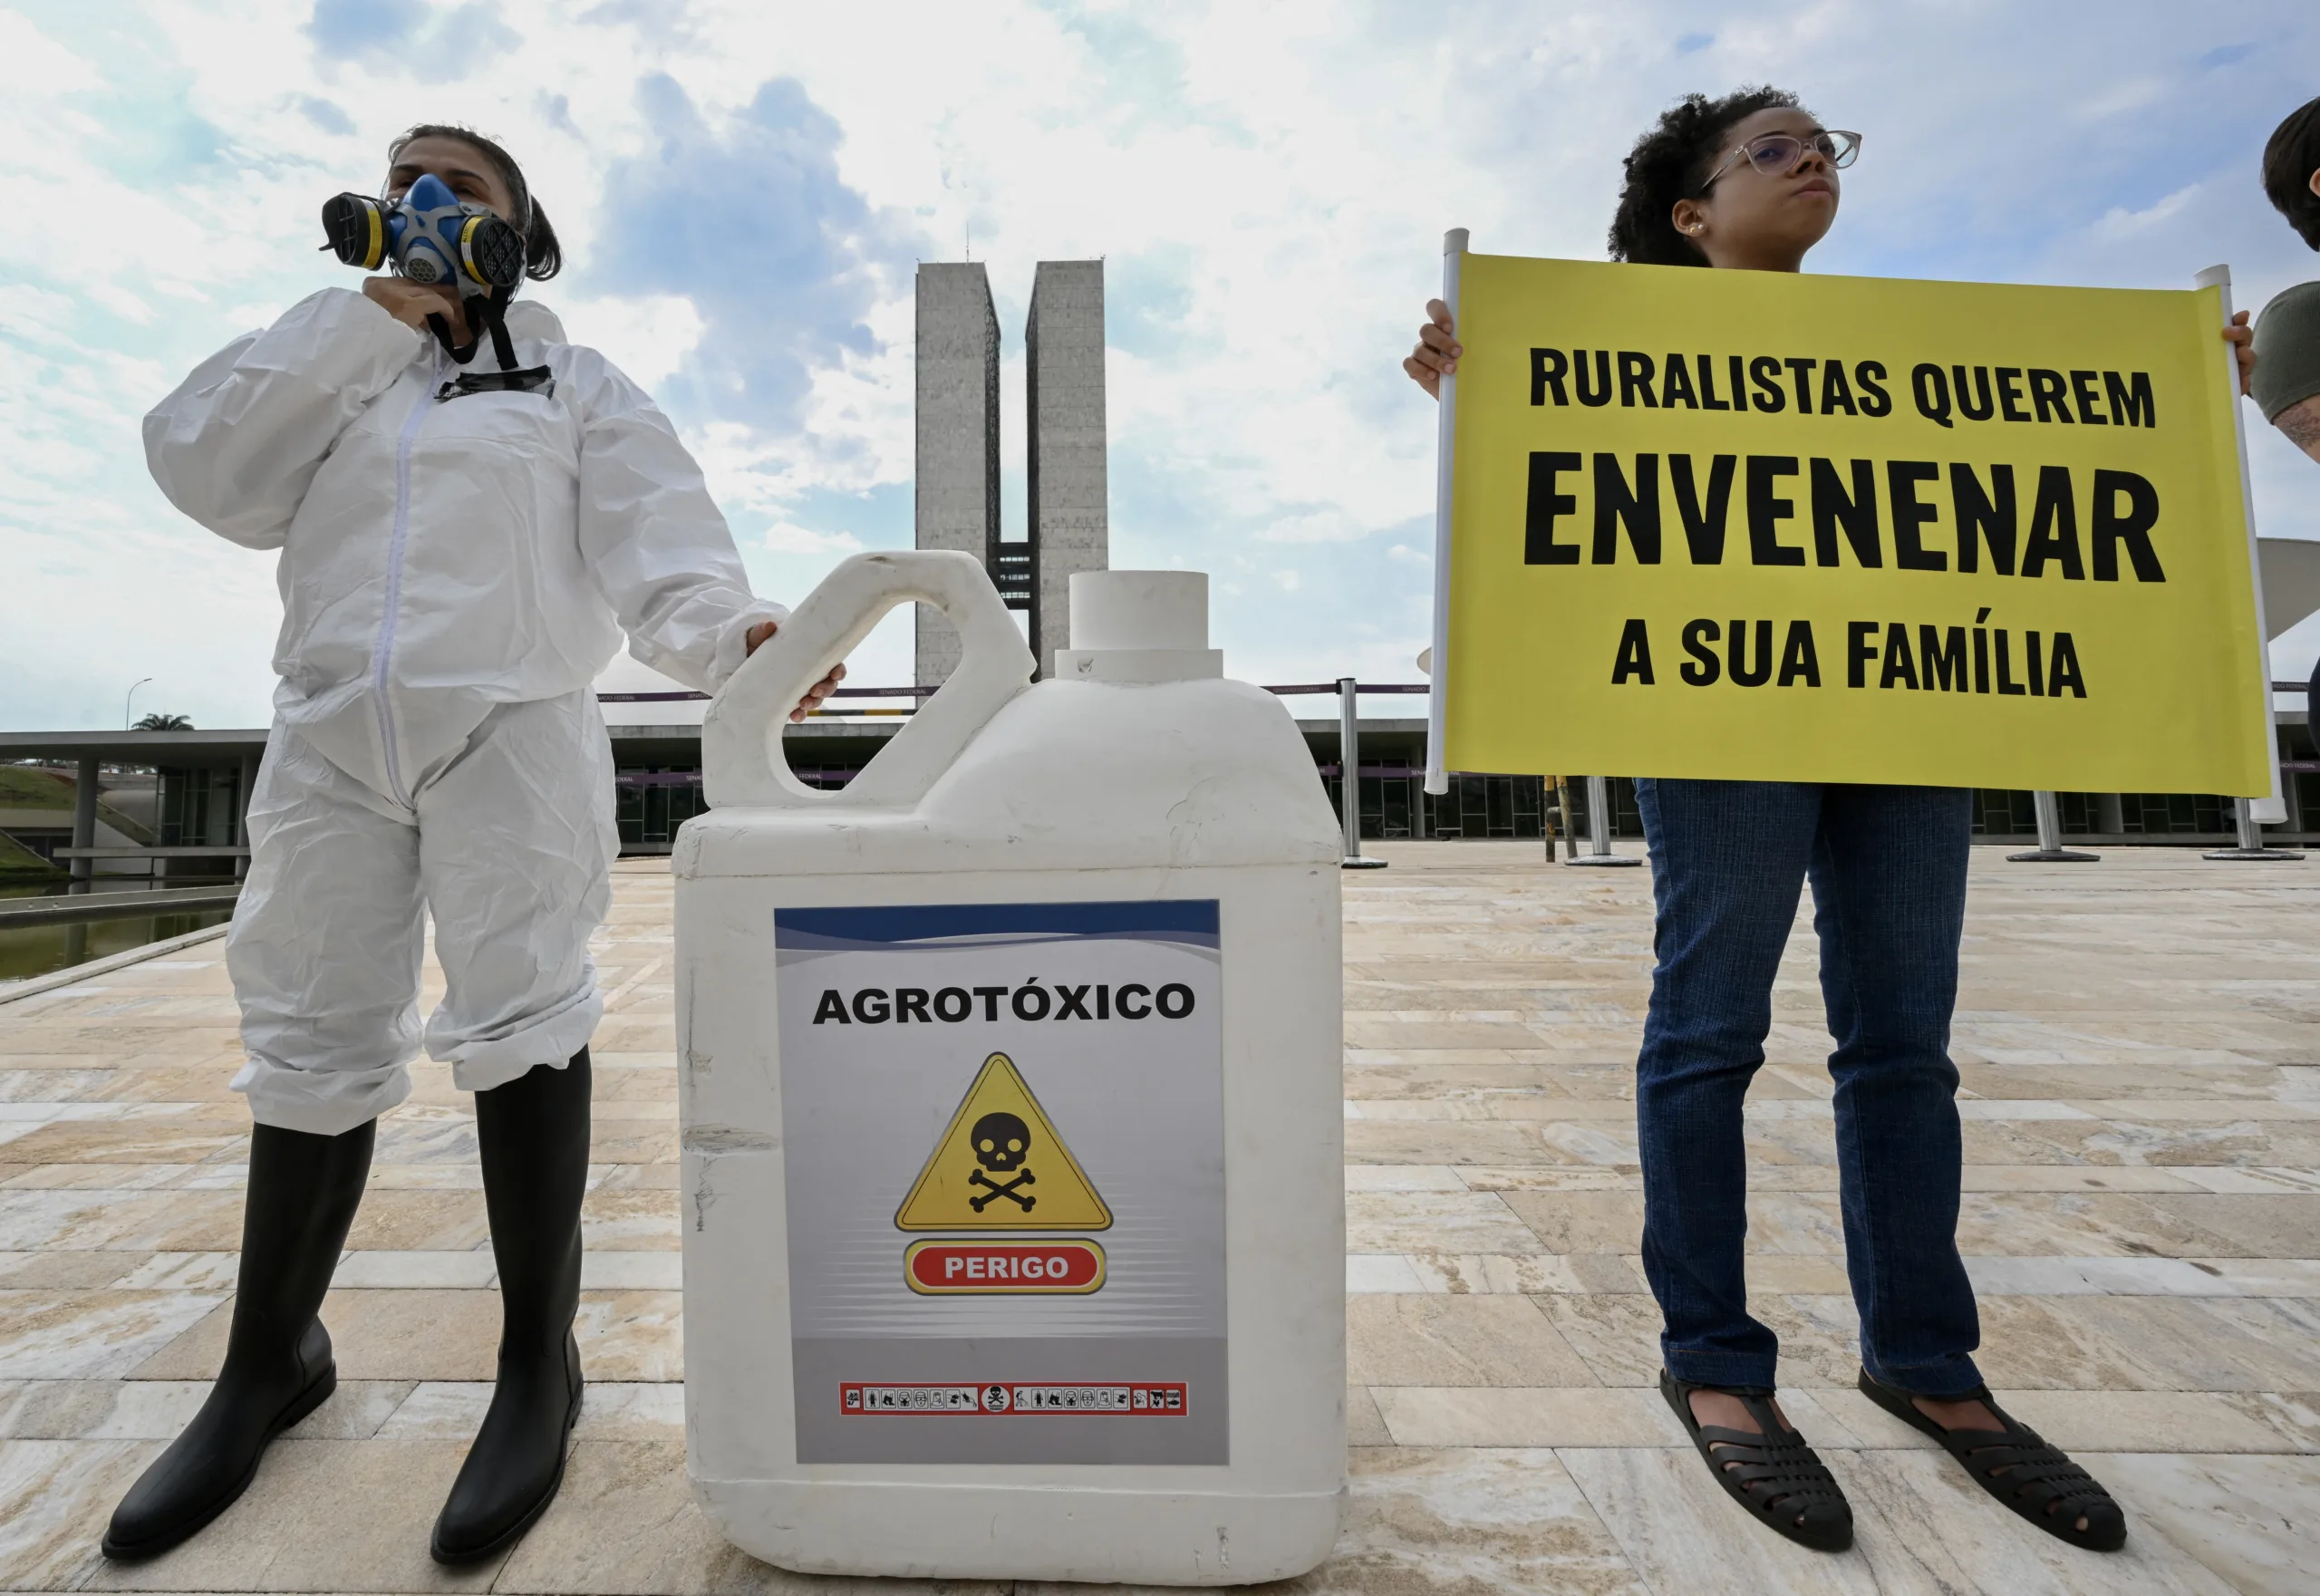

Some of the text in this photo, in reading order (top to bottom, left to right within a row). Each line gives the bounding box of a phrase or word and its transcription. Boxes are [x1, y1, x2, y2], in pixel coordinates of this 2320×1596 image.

[1530, 348, 2156, 429] RURALISTAS QUEREM
[1524, 451, 2166, 583] ENVENENAR
[1611, 606, 2087, 699] A SUA FAMÍLIA
[812, 977, 1195, 1025] AGROTÓXICO
[945, 1257, 1068, 1279] PERIGO
